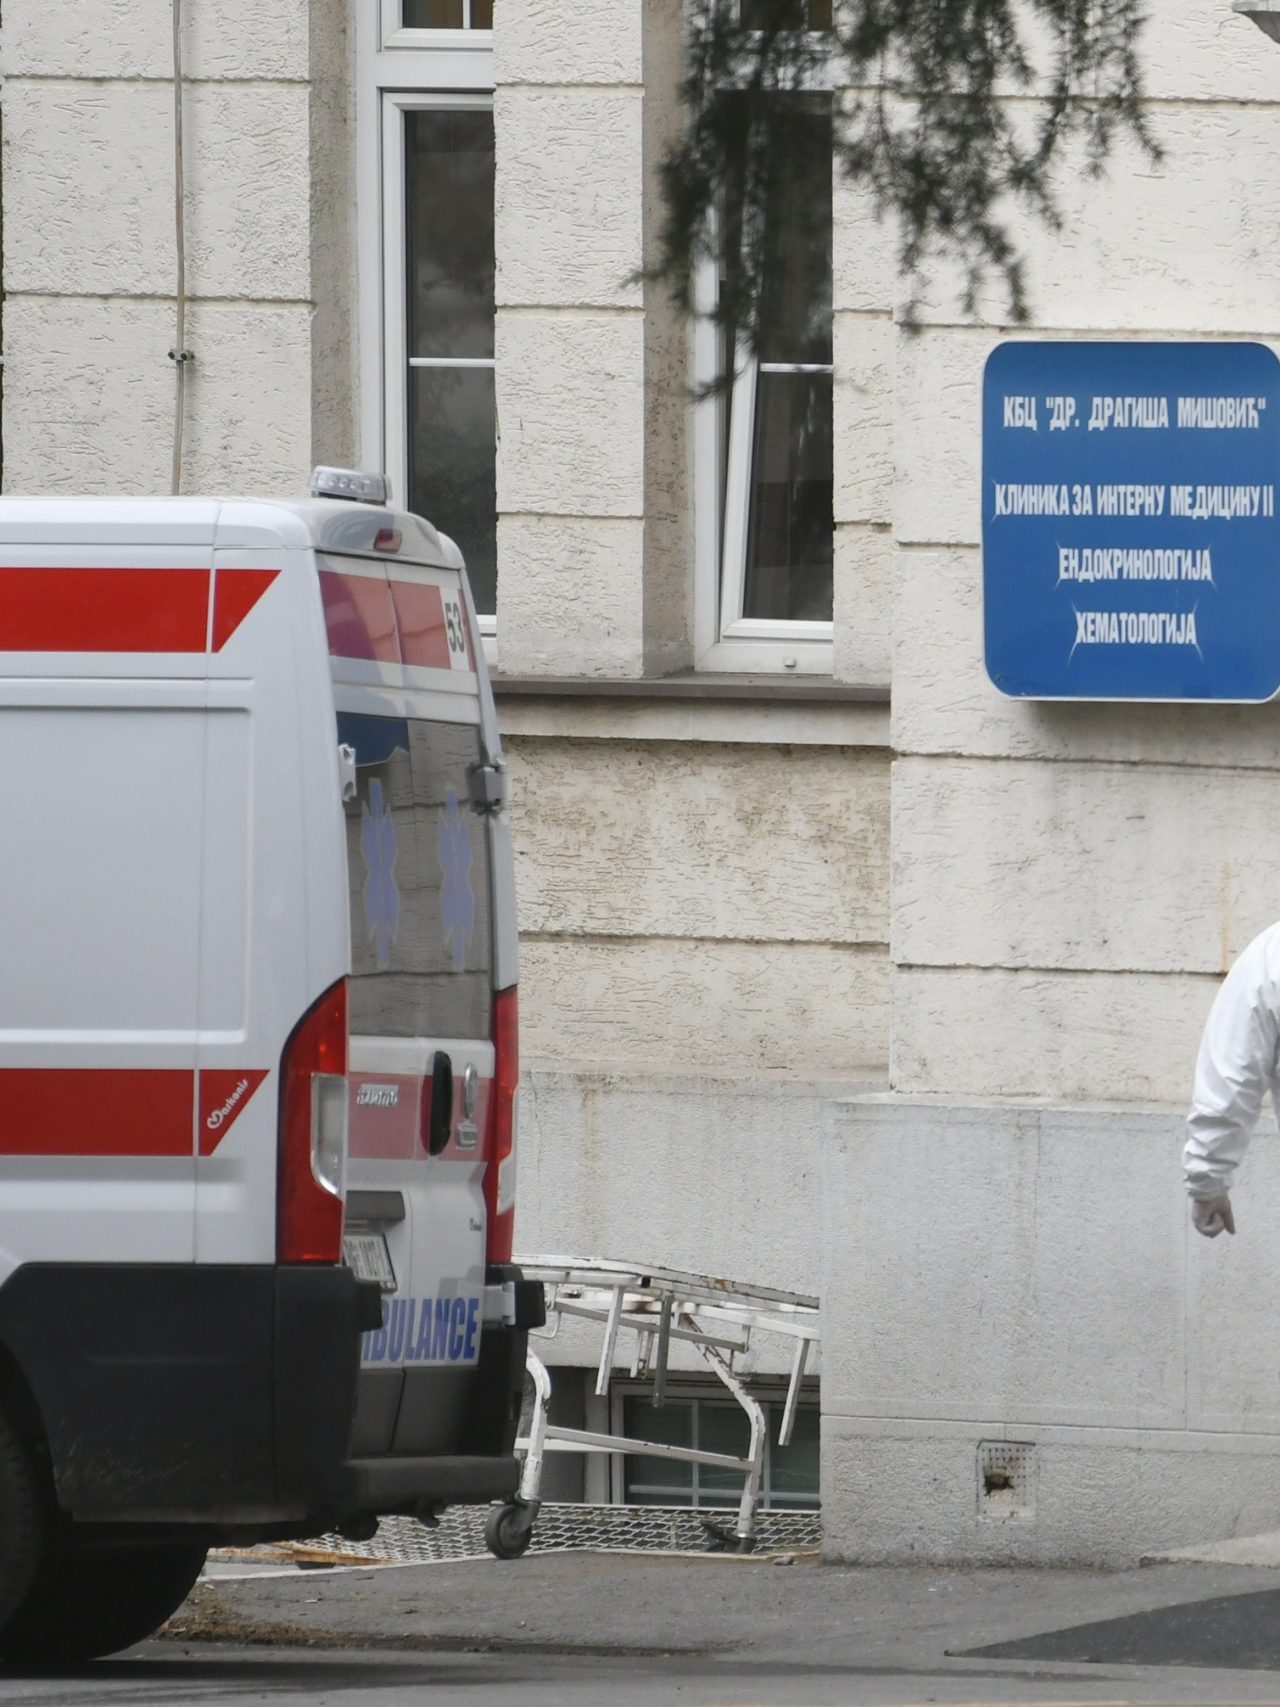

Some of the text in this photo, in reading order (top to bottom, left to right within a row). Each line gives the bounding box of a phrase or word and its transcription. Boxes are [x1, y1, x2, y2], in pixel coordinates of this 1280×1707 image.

[1003, 396, 1038, 432] КБЦ
[1087, 396, 1169, 432] ДРАГИША
[1177, 396, 1266, 430] МИШОВИЋ"
[995, 484, 1070, 516] КЛИНИКА
[1072, 484, 1093, 516] ЗА
[1096, 484, 1166, 516] ИНТЕРНУ
[1170, 485, 1261, 520] МЕДИЦИНУ
[1060, 549, 1212, 582] ЕНДОКРИНОЛОГИЈА
[444, 602, 465, 653] 53
[1076, 612, 1197, 645] ХЕМАТОЛОГИЈА
